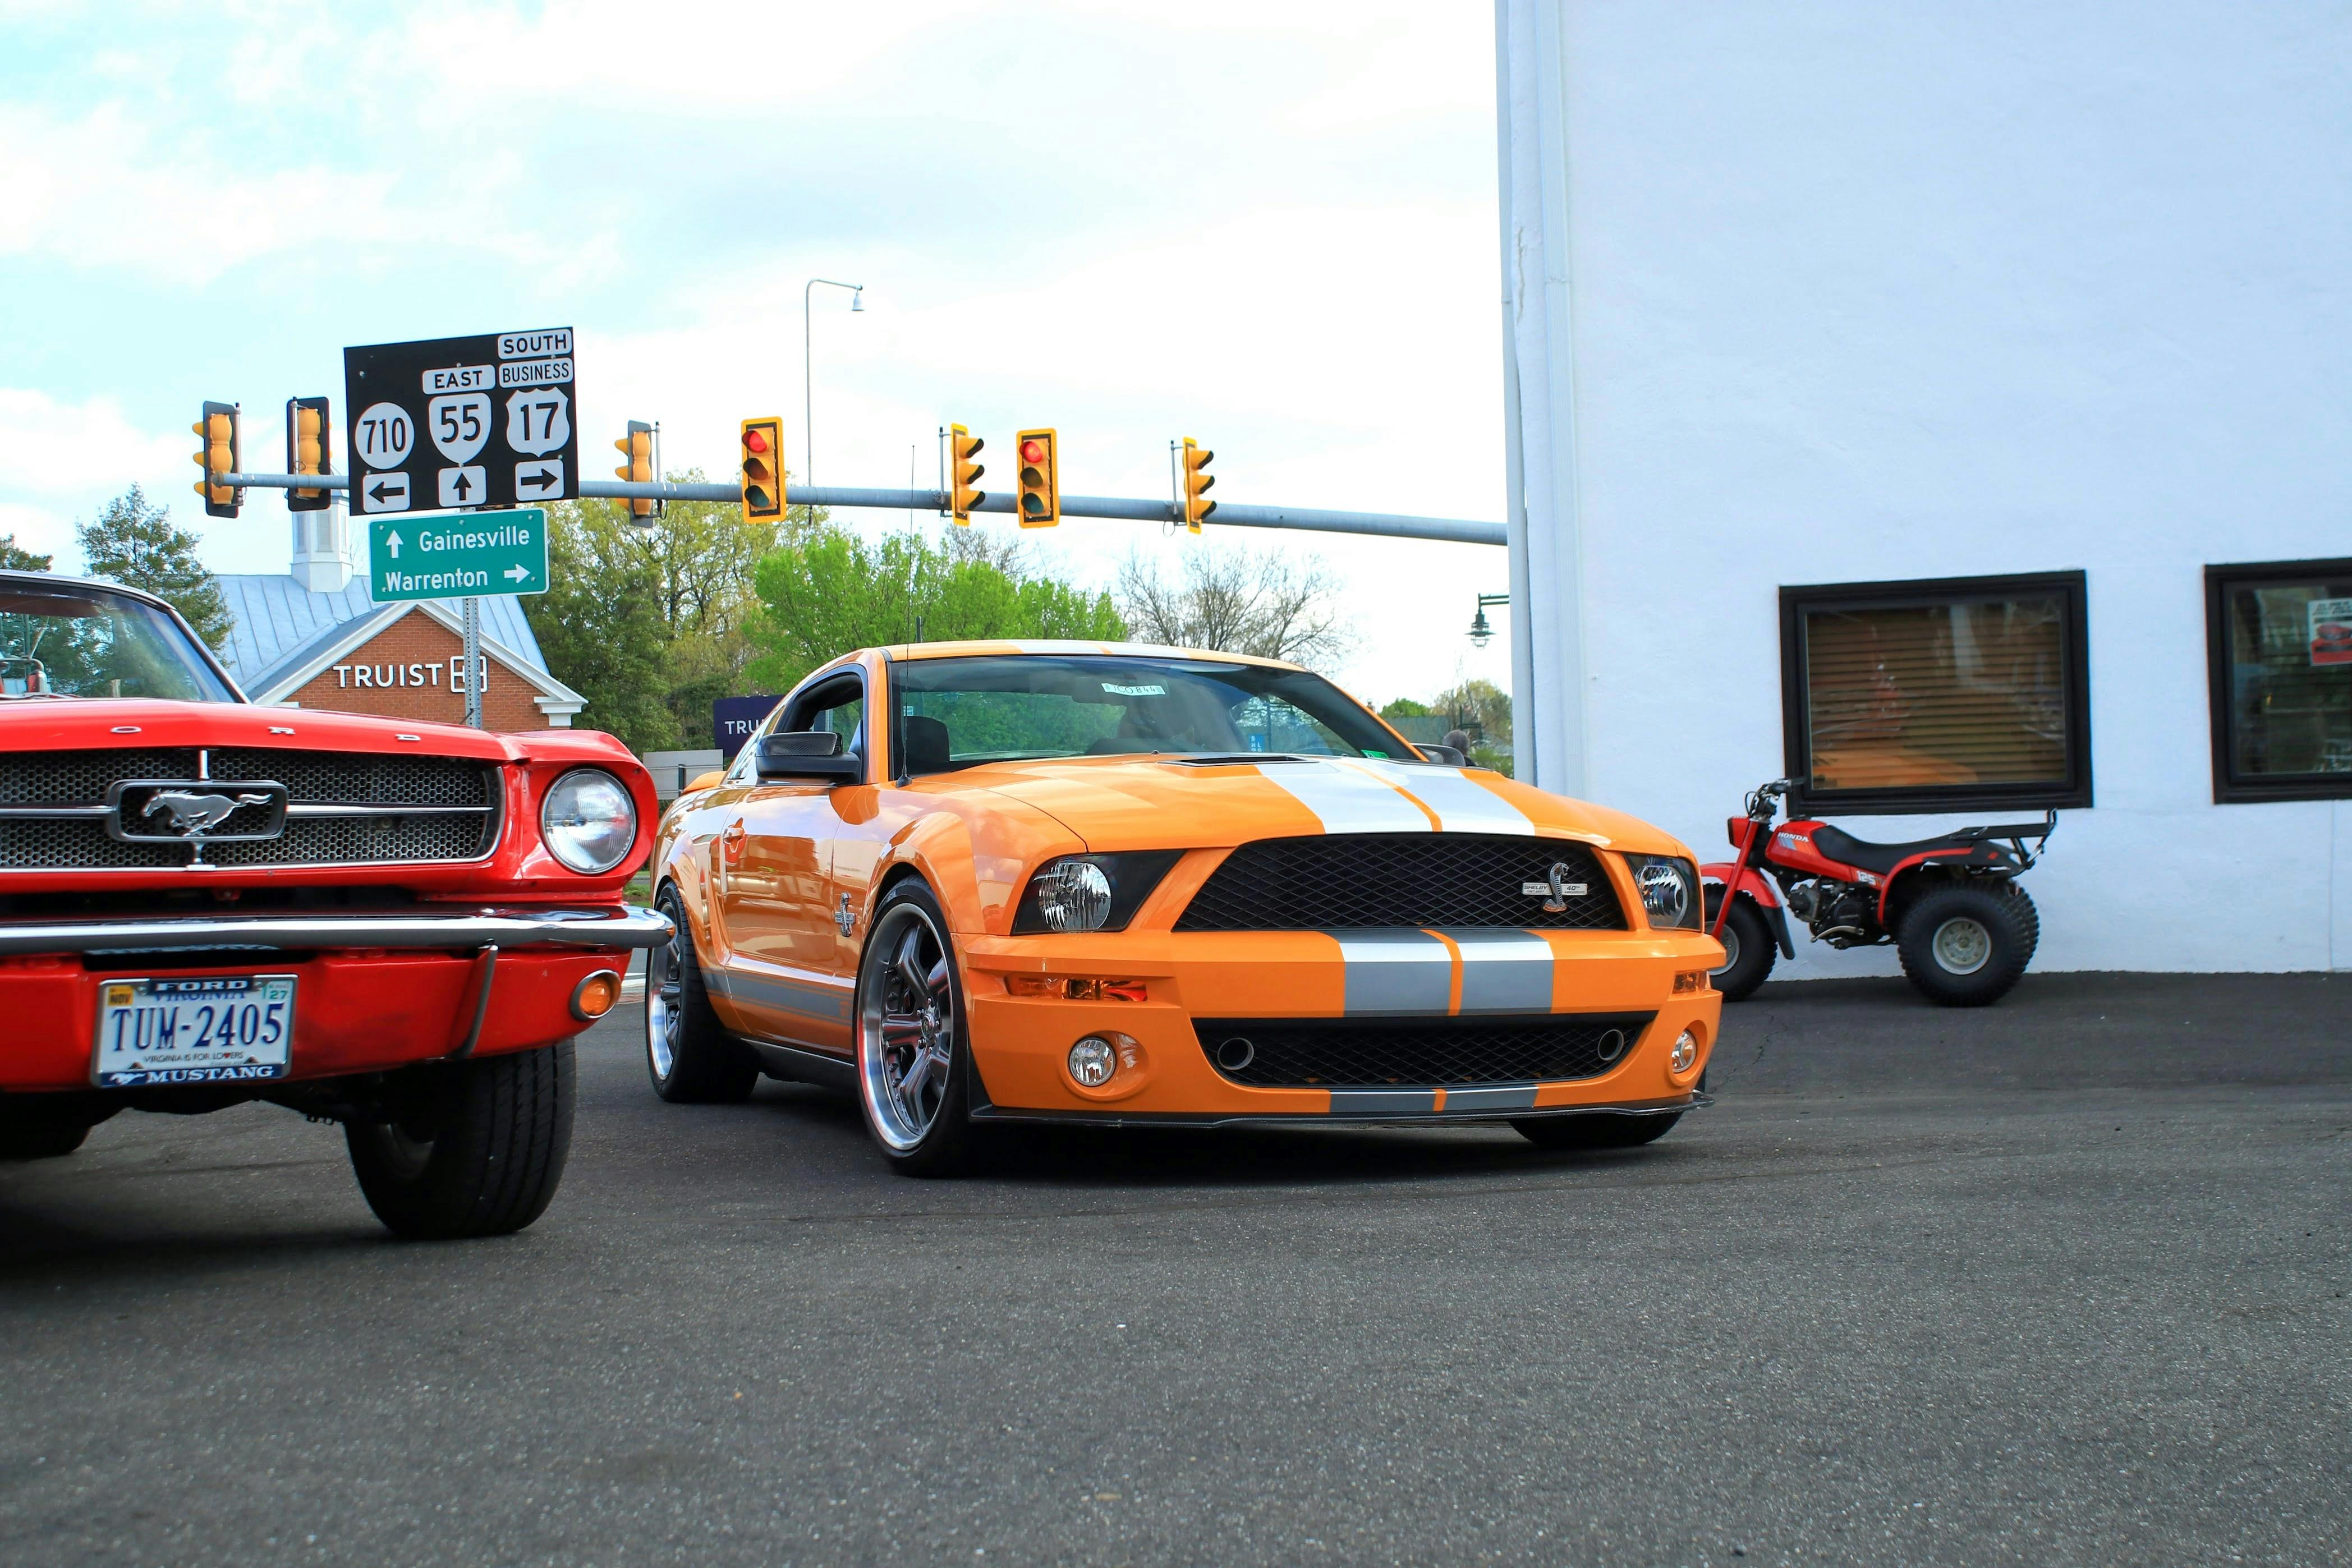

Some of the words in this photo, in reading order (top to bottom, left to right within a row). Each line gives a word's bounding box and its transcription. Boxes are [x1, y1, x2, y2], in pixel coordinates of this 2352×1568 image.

[503, 334, 567, 354] SOUTH
[434, 370, 483, 389] EAST
[503, 363, 569, 383] BUSINESS
[440, 404, 481, 443] 55
[520, 401, 559, 442] 17
[362, 417, 407, 454] 710
[420, 525, 530, 552] Gainesville
[385, 568, 488, 592] Warrenton
[333, 663, 443, 688] TRUIST
[725, 719, 764, 735] TRU
[1777, 832, 1809, 842] HONDA
[155, 980, 248, 991] FORD
[270, 990, 290, 999] 27
[112, 1003, 286, 1051] TUM-2405
[146, 1066, 274, 1083] MUSTANG
